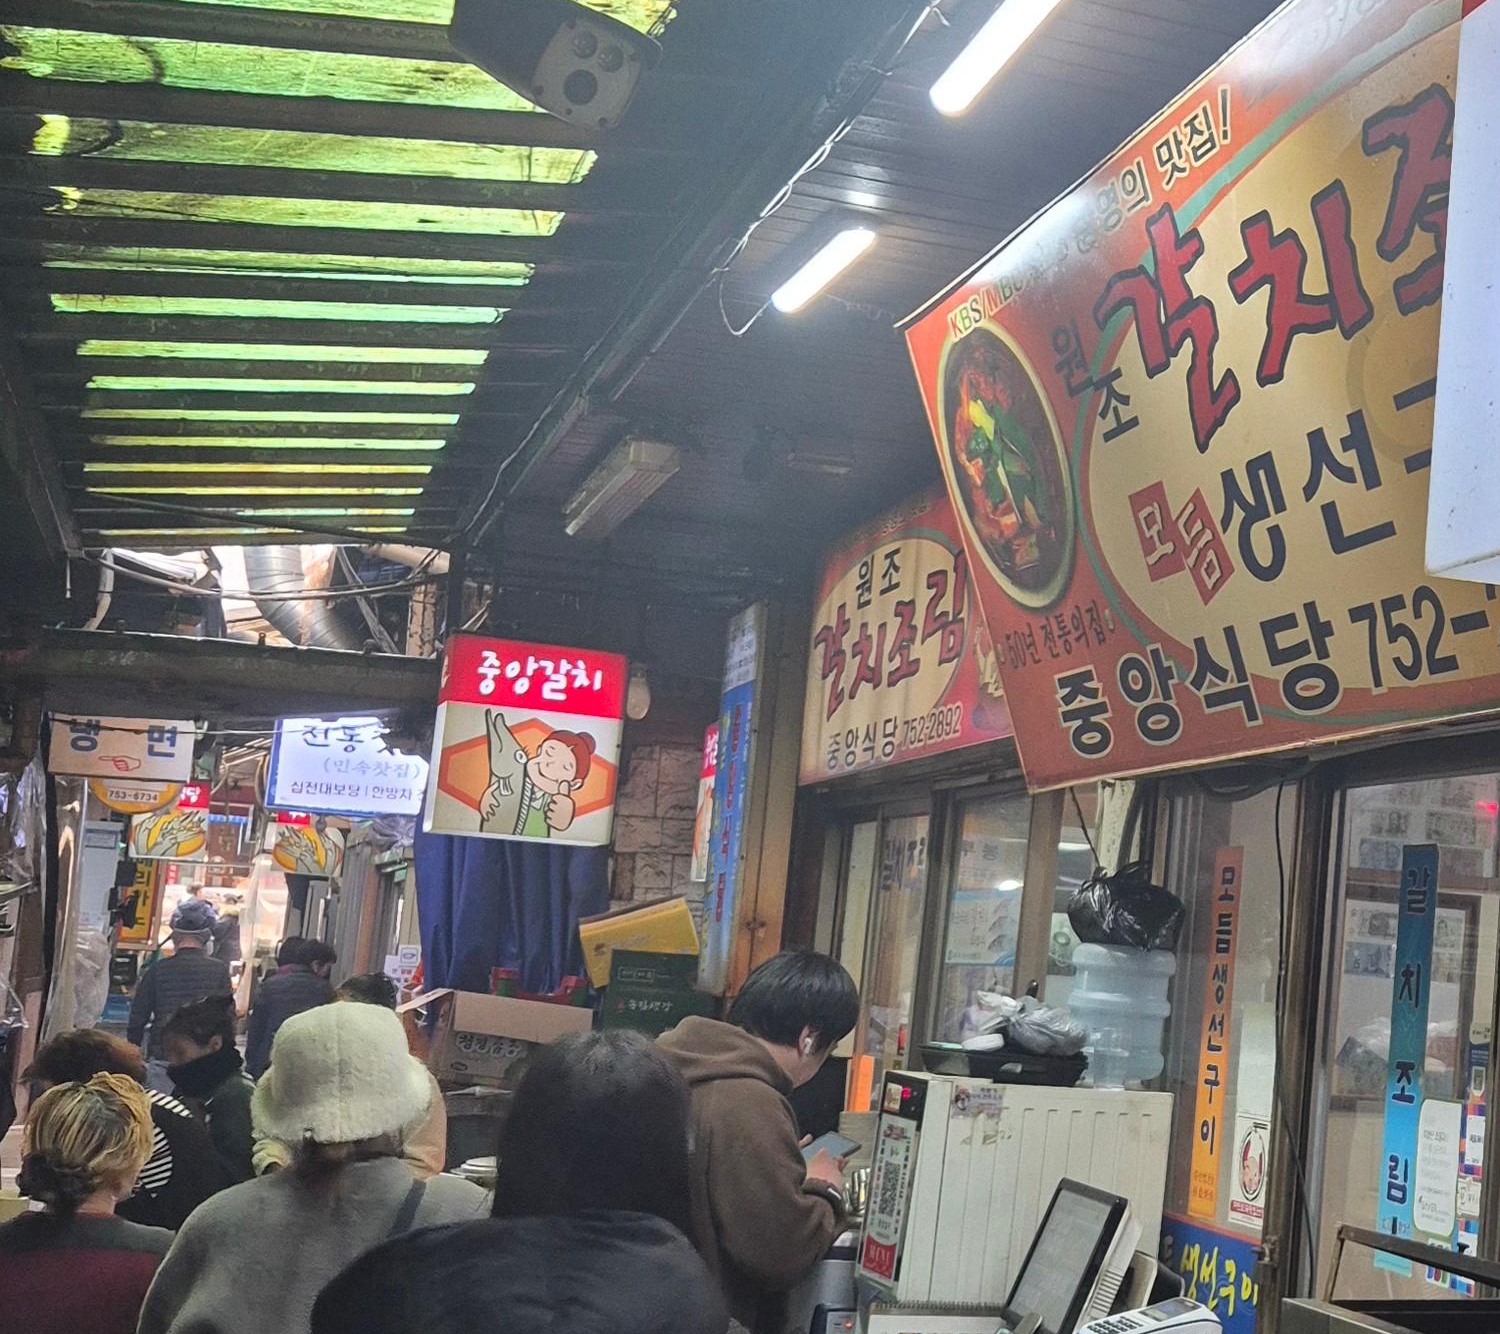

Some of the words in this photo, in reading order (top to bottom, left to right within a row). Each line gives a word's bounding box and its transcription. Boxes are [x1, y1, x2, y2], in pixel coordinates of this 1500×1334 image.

[1154, 85, 1230, 189] 맛집!
[1051, 321, 1140, 443] 원조
[855, 547, 902, 610] 원조
[1137, 501, 1223, 588] 모듬
[477, 650, 602, 701] 중앙갈치
[813, 548, 969, 723] 갈치조림
[1056, 601, 1343, 758] 중앙식당
[827, 716, 898, 771] 중앙식당
[902, 703, 963, 749] 752-2892
[108, 789, 159, 802] 753-6734
[290, 780, 361, 798] 십전대보탕
[372, 782, 412, 801] 한방차
[1198, 866, 1238, 1157] 모듬생선구이
[1386, 865, 1433, 1205] 갈치조림
[1181, 1243, 1258, 1317] 생선구이
